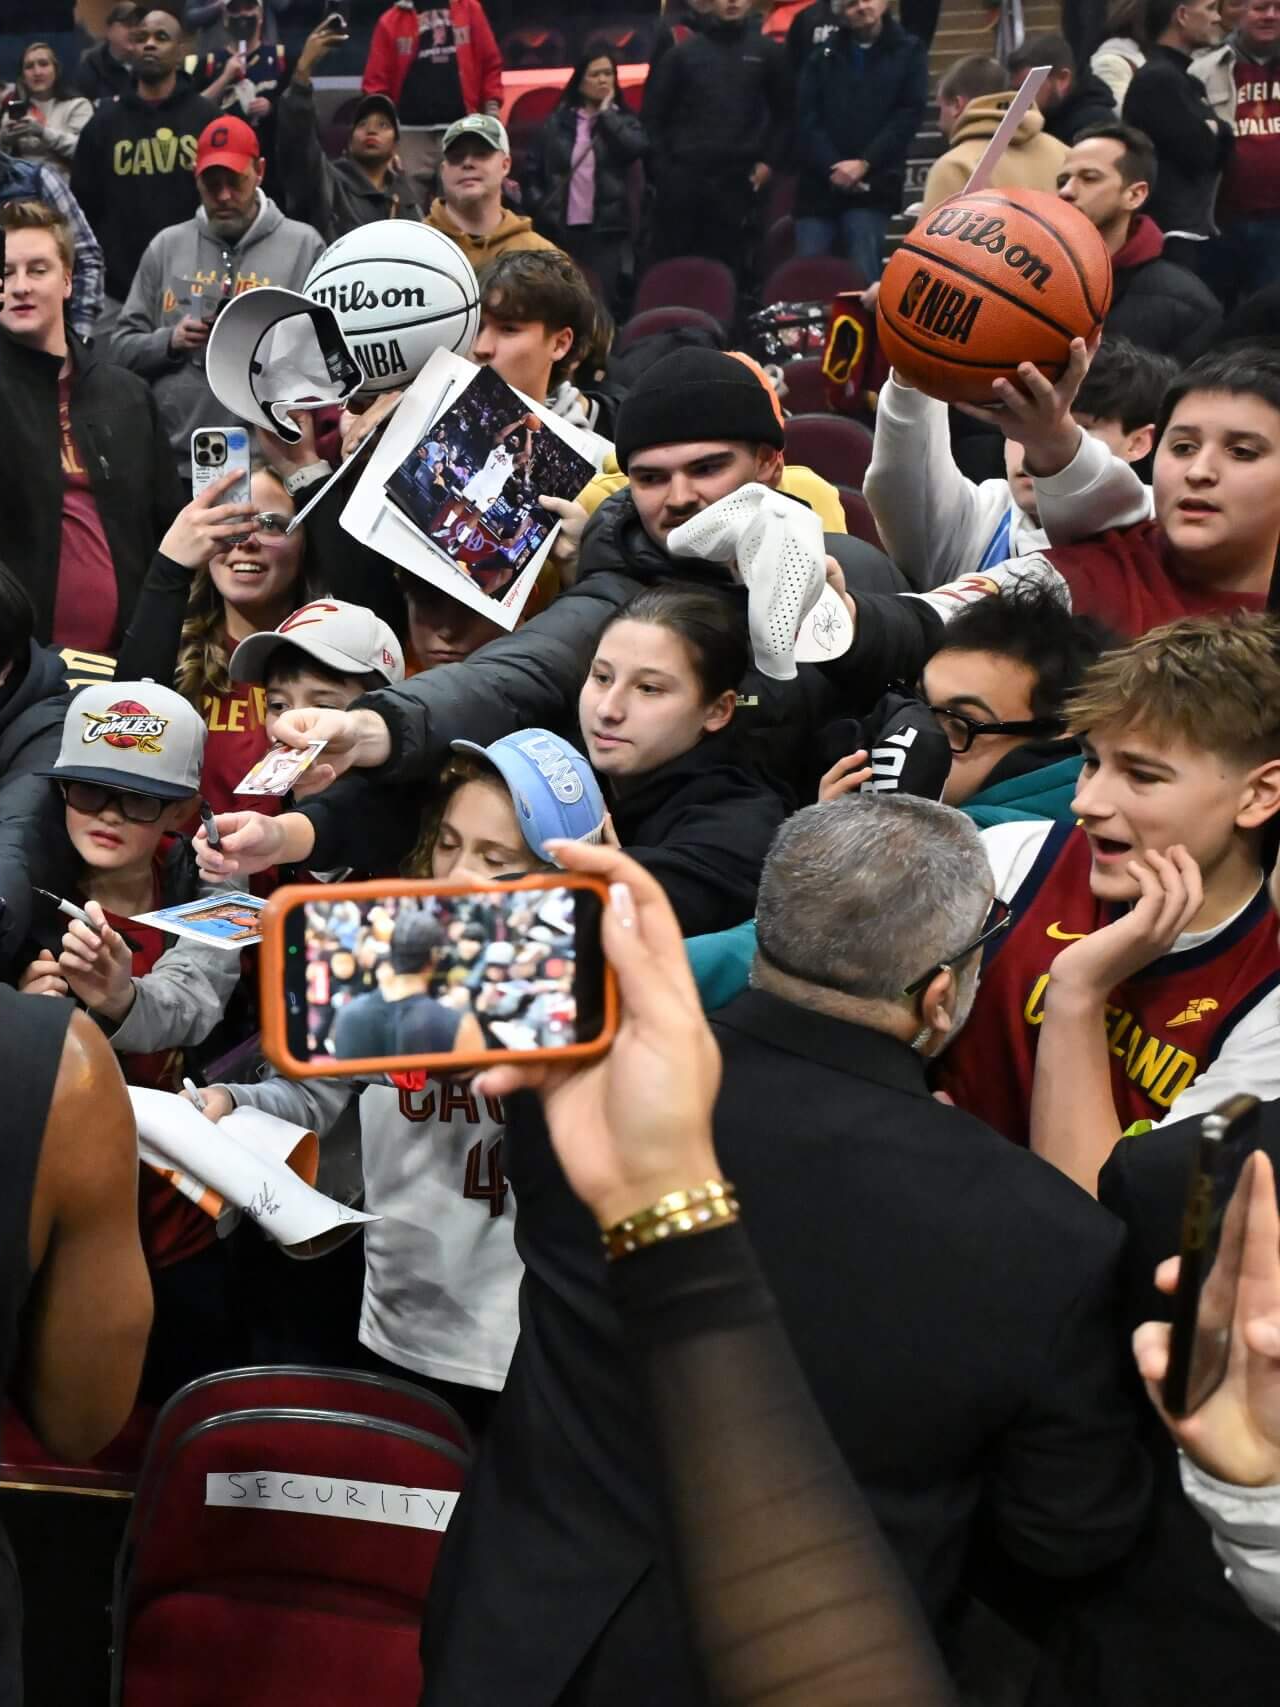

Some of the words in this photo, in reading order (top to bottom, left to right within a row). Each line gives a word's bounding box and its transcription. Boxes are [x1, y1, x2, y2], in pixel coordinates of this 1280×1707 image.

[113, 127, 198, 176] CAVS
[926, 208, 1053, 290] Wilson
[916, 278, 984, 345] NBA
[353, 338, 408, 379] NBA
[519, 737, 584, 804] LAND
[228, 1473, 446, 1526] SECURITY
